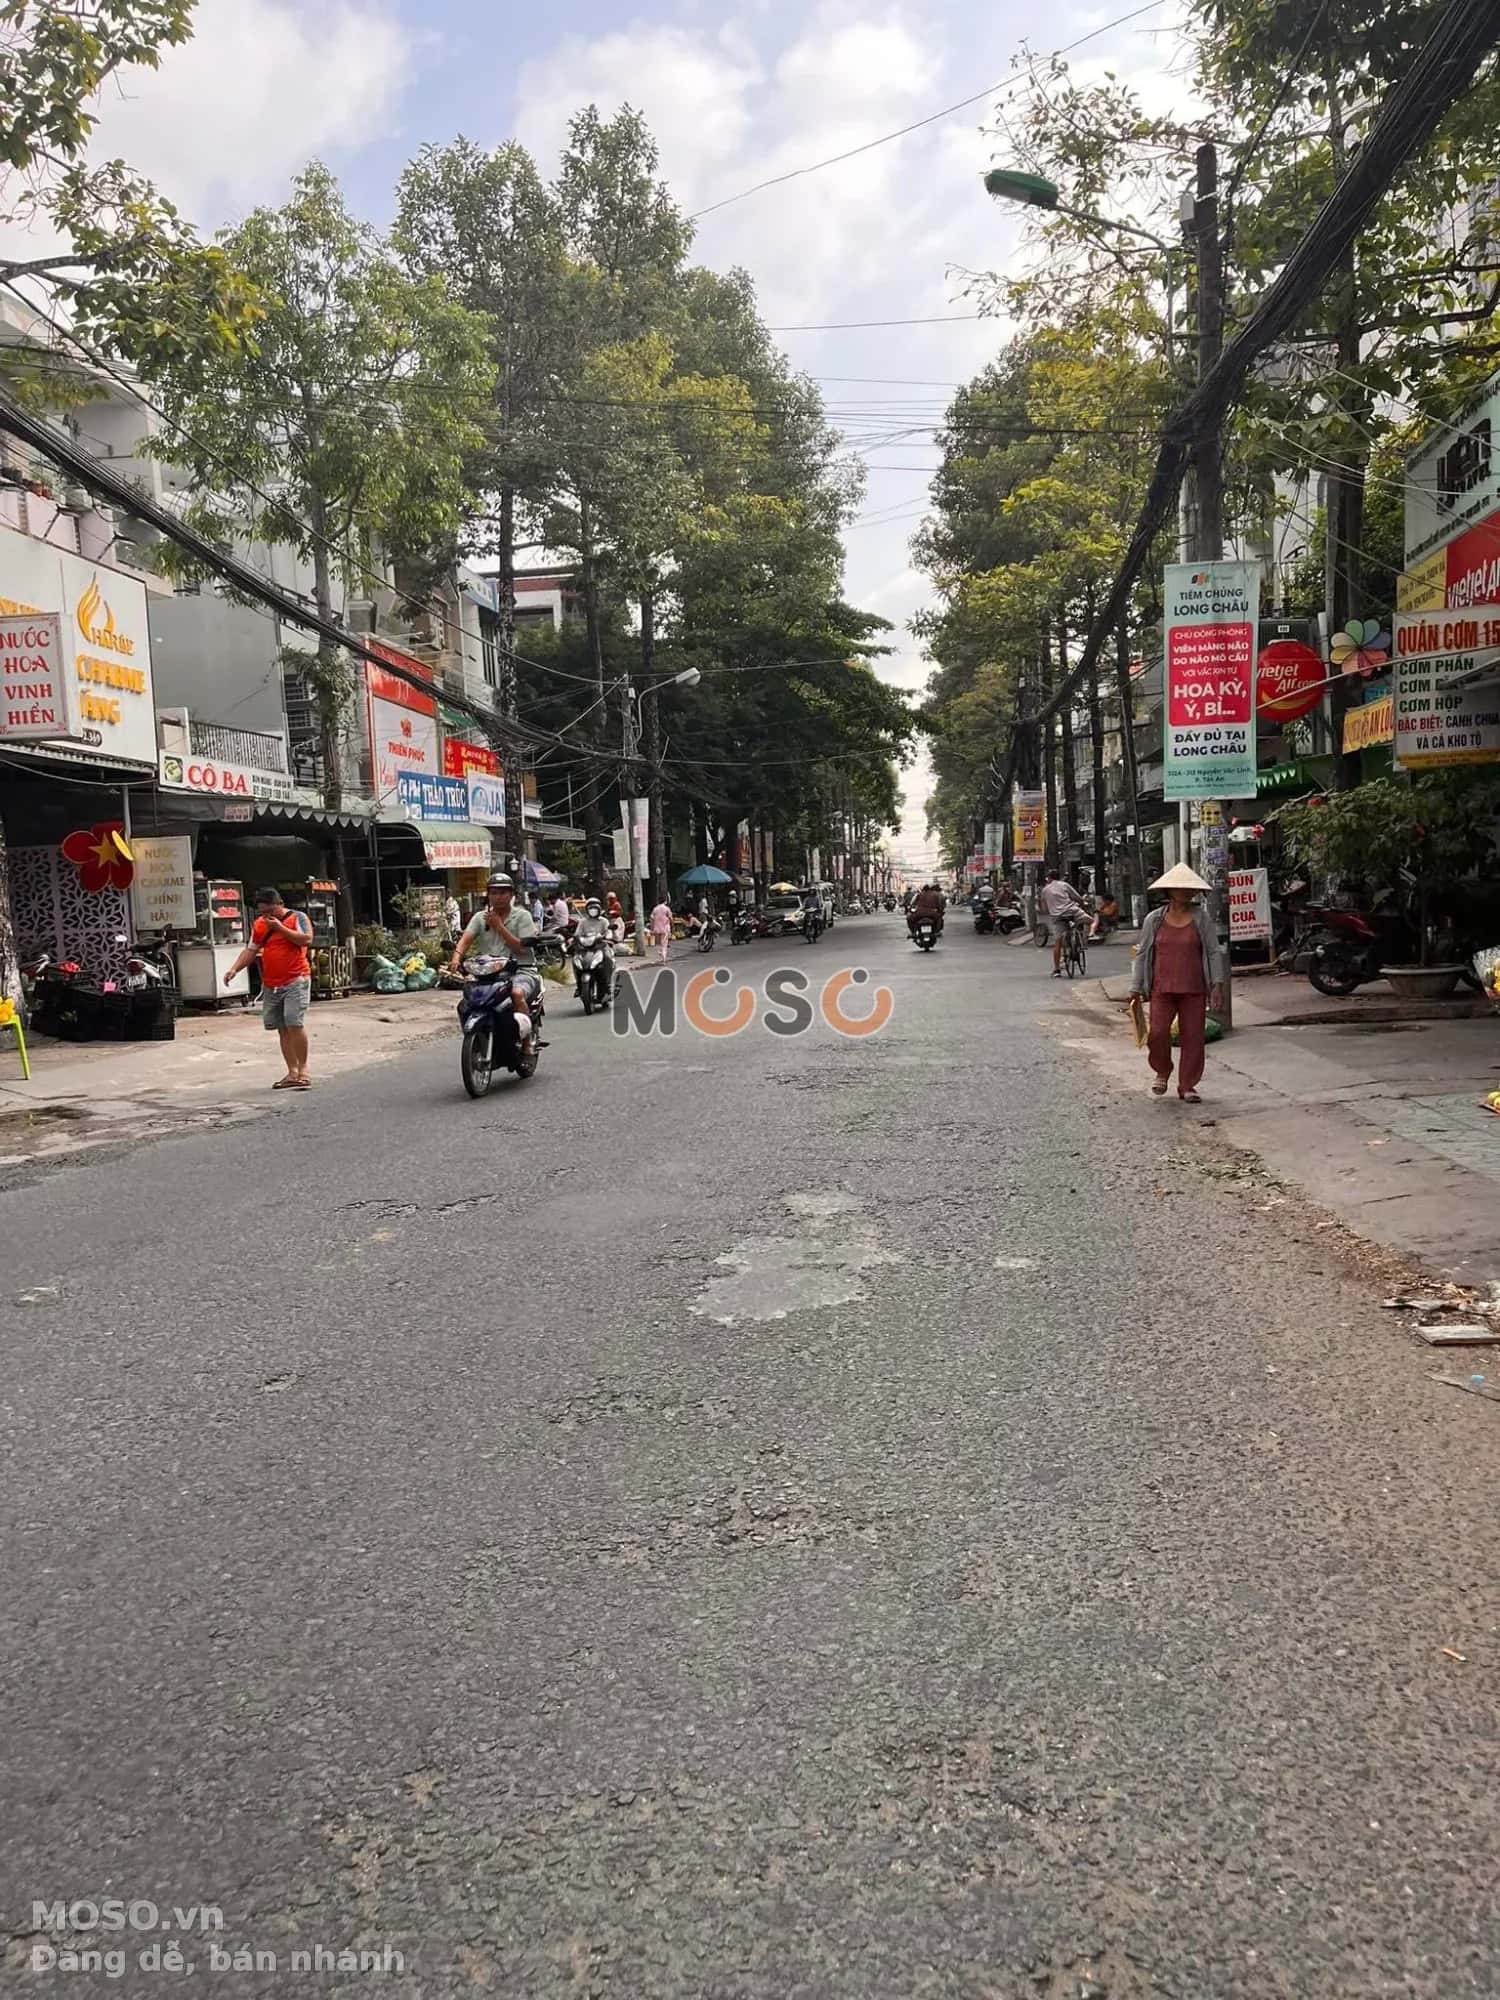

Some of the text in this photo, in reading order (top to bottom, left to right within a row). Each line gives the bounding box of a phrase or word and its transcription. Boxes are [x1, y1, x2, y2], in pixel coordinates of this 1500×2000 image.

[1174, 599, 1249, 617] LONG CHÂU
[1397, 620, 1440, 656] QUÁN
[1443, 619, 1479, 649] CƠM
[4, 655, 50, 674] HOA
[1173, 657, 1188, 666] DO
[1399, 655, 1474, 676] CƠM PHẦN
[4, 683, 53, 700] VINH
[1173, 678, 1247, 699] HOA KỲ,
[1399, 678, 1431, 694] CƠM
[1184, 700, 1201, 720] Ý,
[1399, 697, 1431, 713] CƠM
[8, 702, 55, 726] HIỂN
[1446, 715, 1472, 729] CANH
[1173, 741, 1247, 757] LONG CHÂU
[1416, 735, 1429, 750] VÀ
[1447, 733, 1467, 748] KHO
[187, 763, 217, 787] CÔ
[222, 771, 248, 793] BA
[1232, 910, 1256, 923] CUA
